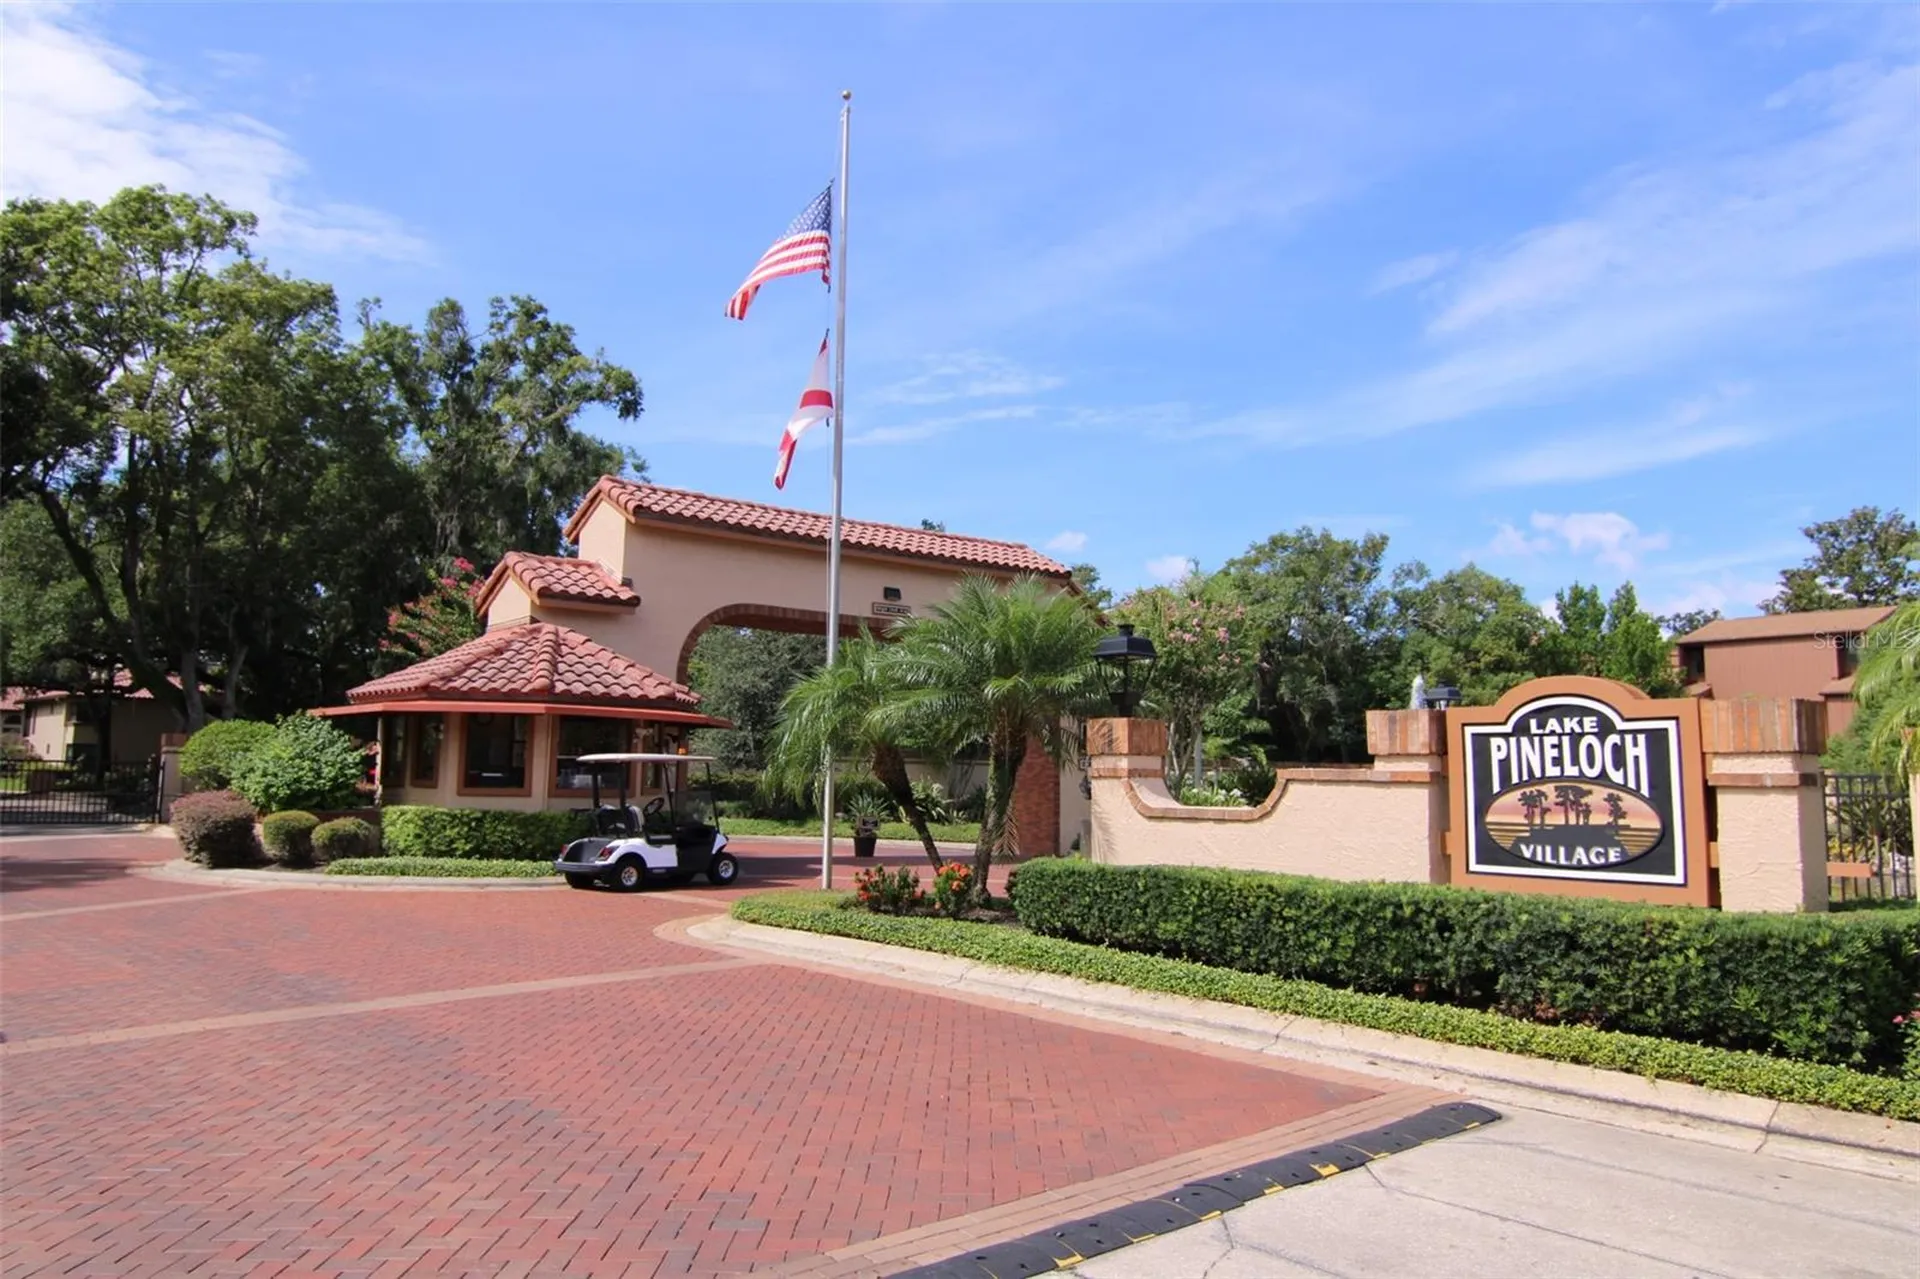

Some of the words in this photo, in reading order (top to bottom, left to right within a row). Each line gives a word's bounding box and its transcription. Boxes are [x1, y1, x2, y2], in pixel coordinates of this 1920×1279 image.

[1529, 716, 1599, 735] LAKE
[1489, 733, 1650, 798] PINELOCH
[1519, 843, 1622, 865] VILLAGE
